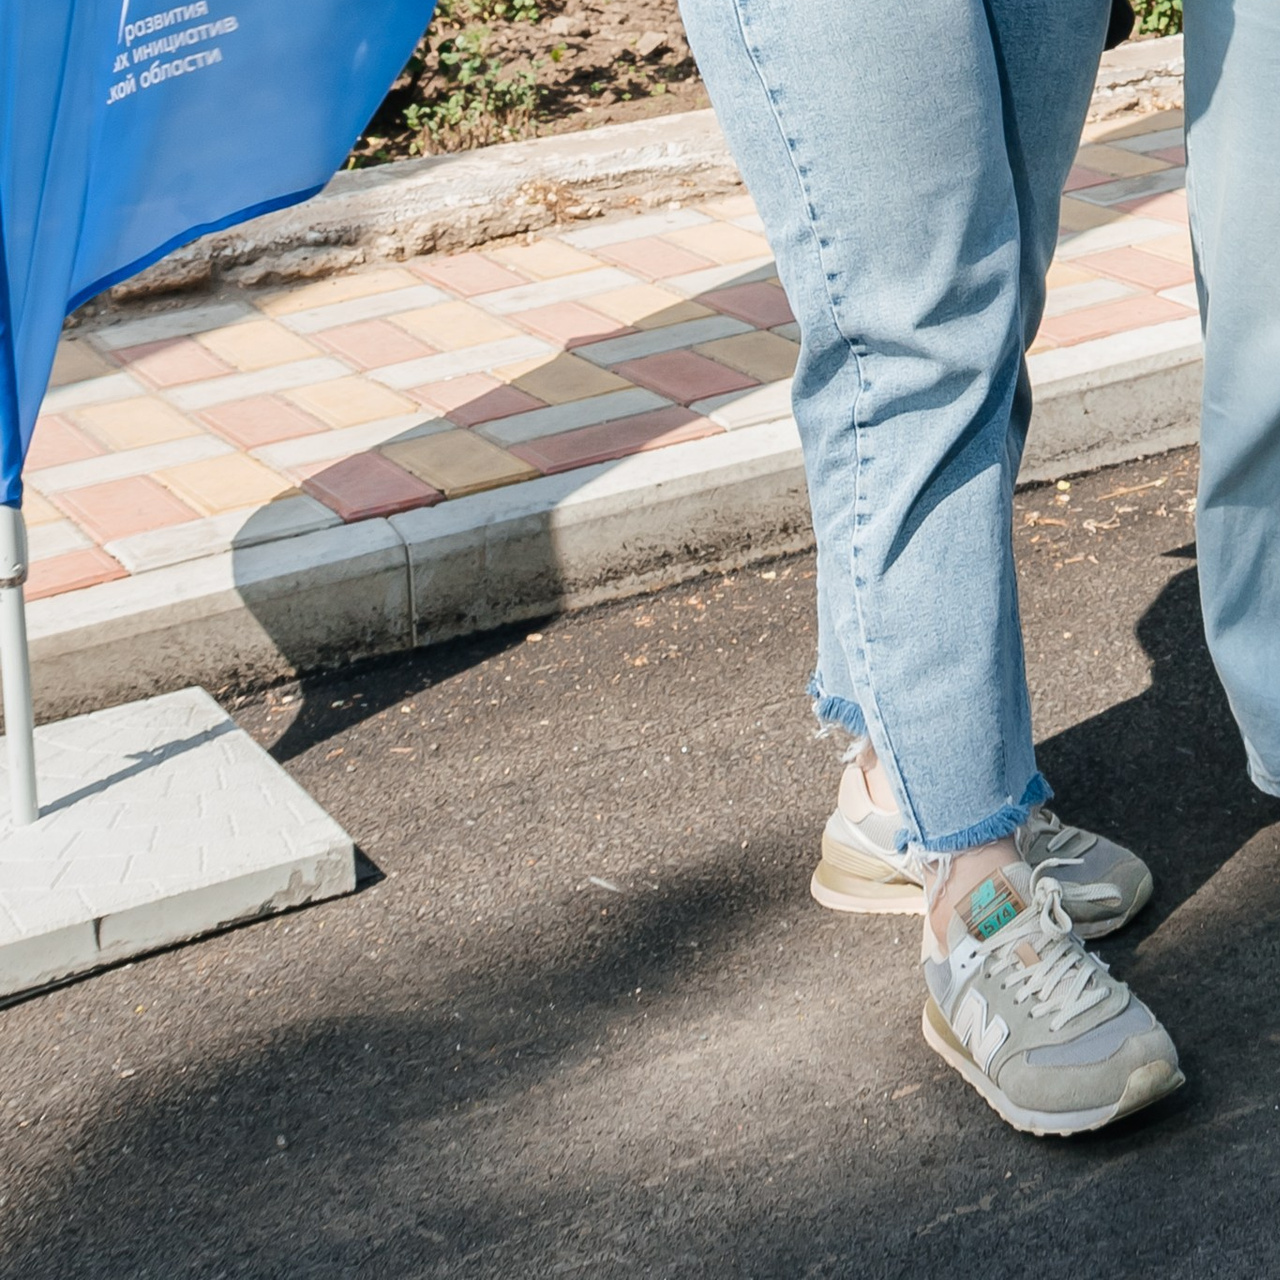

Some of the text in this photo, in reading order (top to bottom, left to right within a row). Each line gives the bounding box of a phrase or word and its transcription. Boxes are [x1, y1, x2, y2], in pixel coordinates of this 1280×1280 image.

[124, 0, 209, 47] развития
[133, 16, 240, 55] инициатив
[139, 47, 223, 89] области
[983, 906, 1012, 935] 574
